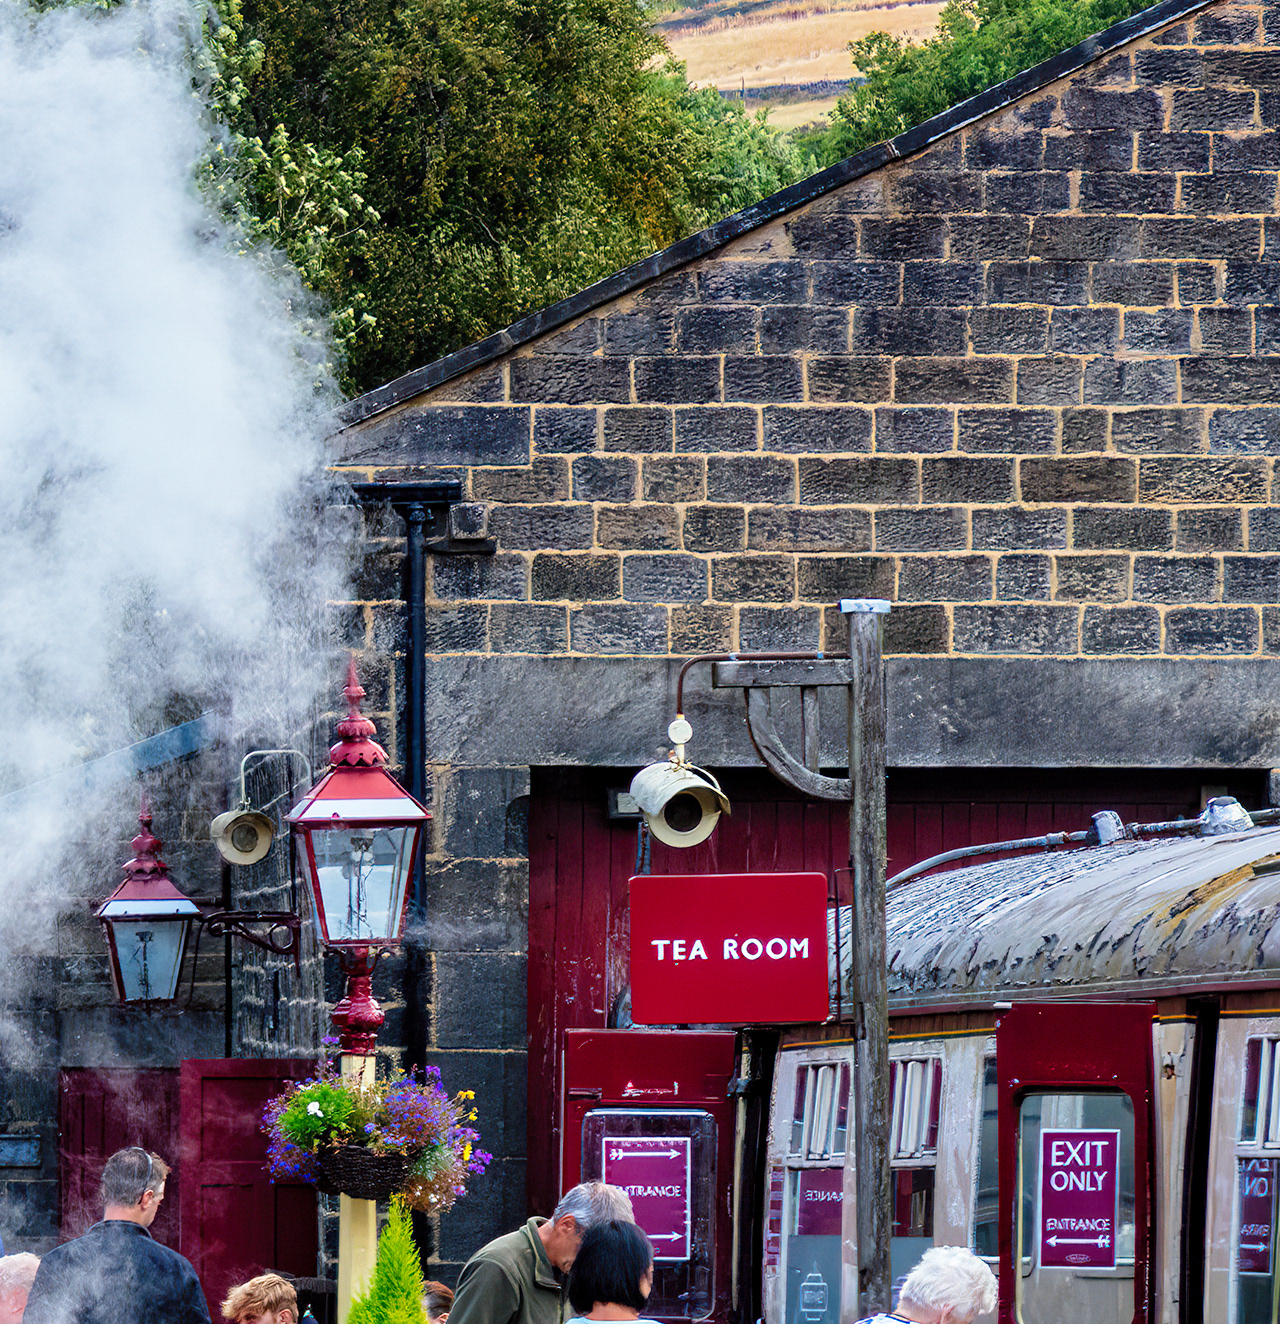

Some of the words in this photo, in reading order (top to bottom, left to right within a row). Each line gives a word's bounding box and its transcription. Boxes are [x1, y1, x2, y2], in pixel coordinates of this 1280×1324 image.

[651, 938, 708, 962] TEA
[723, 936, 810, 960] ROOM
[1050, 1140, 1109, 1167] EXIT
[1049, 1170, 1108, 1192] ONLY
